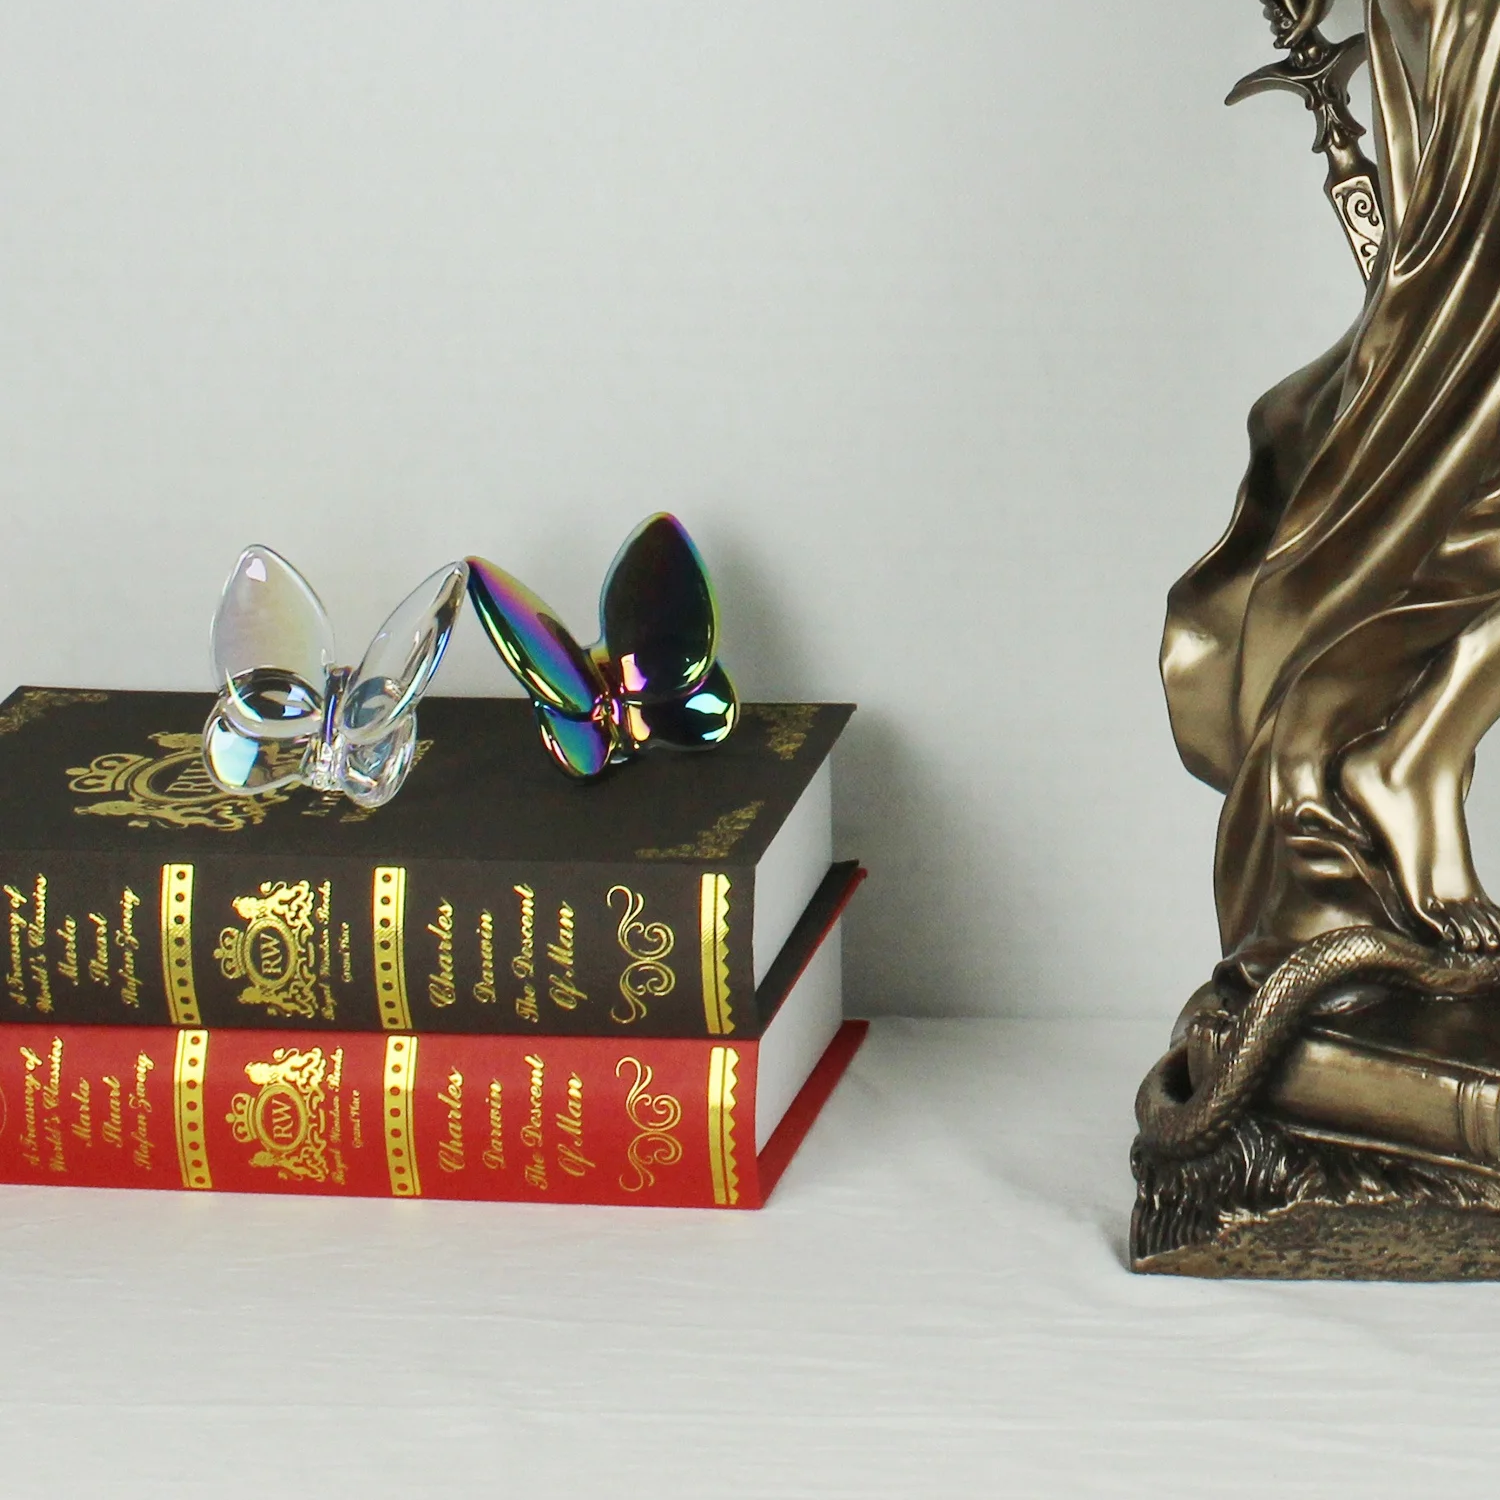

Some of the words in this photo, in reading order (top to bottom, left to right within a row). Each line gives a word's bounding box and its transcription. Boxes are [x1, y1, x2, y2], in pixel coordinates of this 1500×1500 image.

[4, 885, 27, 908] of
[28, 873, 47, 948] Classics
[511, 883, 534, 978] Descent
[6, 912, 27, 990] Treasury
[260, 933, 282, 974] RW
[427, 897, 455, 1007] Charles
[473, 909, 496, 1003] Darwin
[547, 901, 574, 977] Man
[516, 984, 539, 1023] The
[549, 974, 588, 1009] Of
[20, 1047, 42, 1070] of
[43, 1036, 62, 1109] Classics
[20, 1074, 41, 1151] Treasury
[272, 1099, 293, 1139] RW
[438, 1067, 465, 1172] Charles
[482, 1079, 505, 1169] Darwin
[521, 1054, 544, 1147] Descent
[555, 1073, 582, 1147] Man
[525, 1152, 548, 1190] The
[557, 1144, 596, 1177] Of
